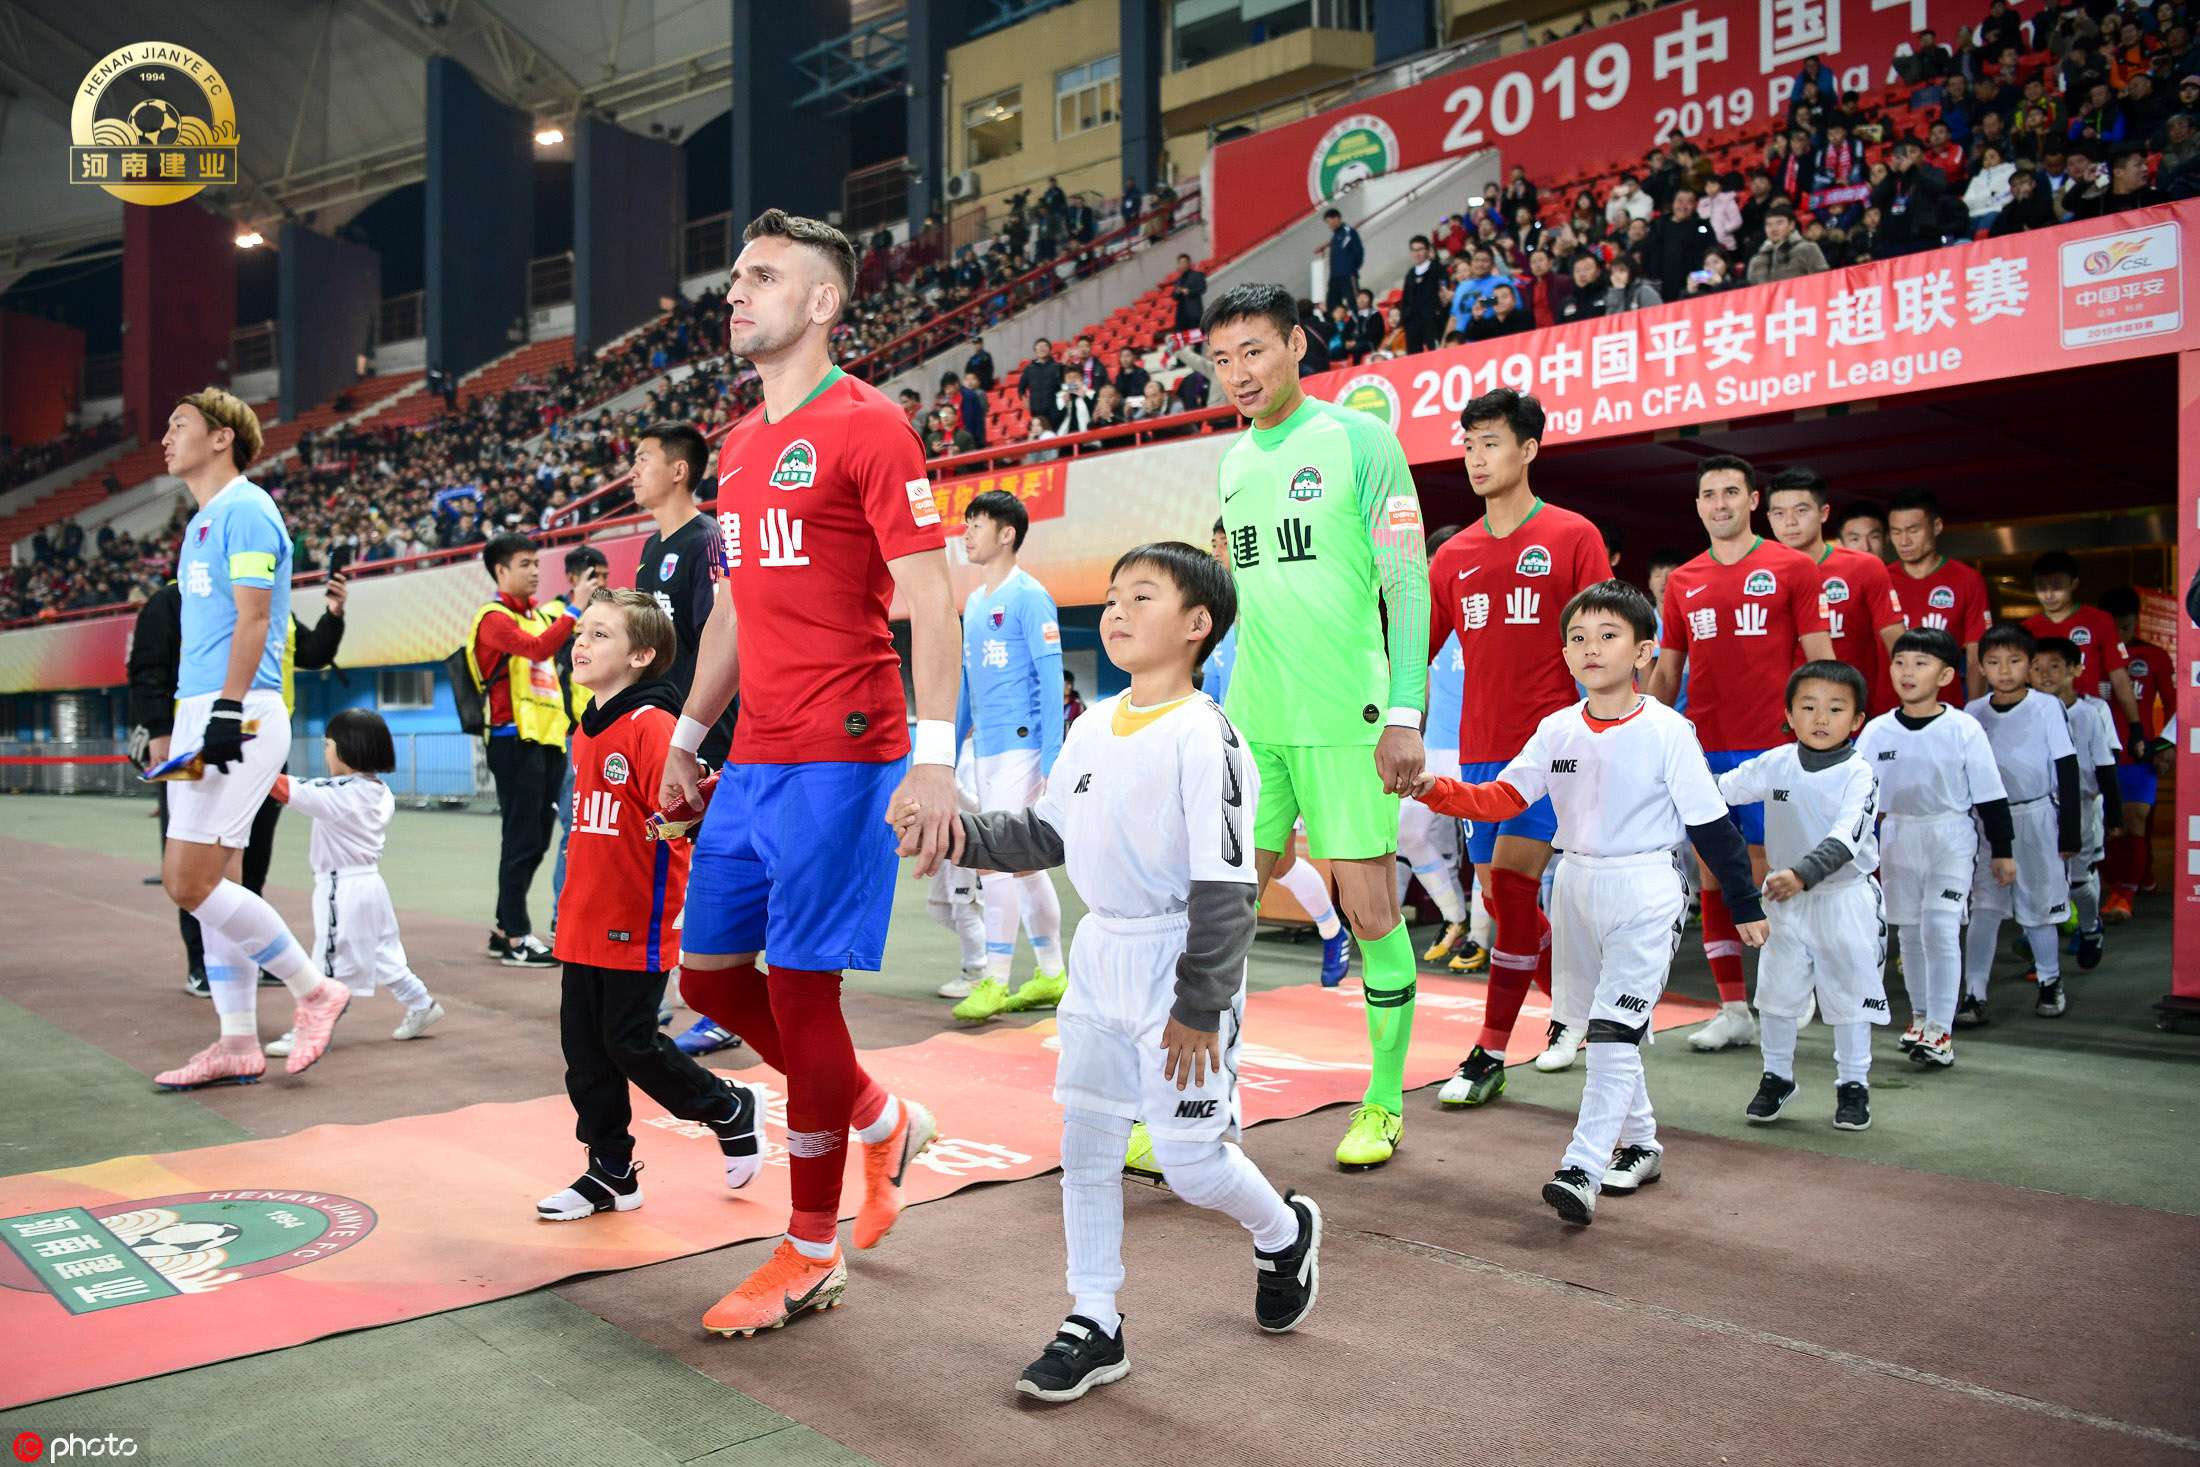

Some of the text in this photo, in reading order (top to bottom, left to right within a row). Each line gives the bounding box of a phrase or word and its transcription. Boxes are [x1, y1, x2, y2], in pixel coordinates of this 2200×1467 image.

[1654, 87, 1754, 146] 2019
[2121, 257, 2152, 271] CSL
[2076, 278, 2165, 307] 中国平安
[1591, 396, 1632, 424] An
[1642, 381, 1706, 415] CFA
[1716, 369, 1817, 406] Super
[1828, 347, 1962, 391] League
[1230, 518, 1317, 571] 建业
[1461, 587, 1541, 632] 建业
[1687, 602, 1768, 642] 建业
[1550, 759, 1578, 773] NIKE
[1941, 888, 1964, 902] NIKE
[1615, 994, 1649, 1013] NIKE
[1862, 998, 1888, 1011] NIKE
[1174, 1099, 1219, 1118] NIKE
[209, 1191, 363, 1258] HENAN JIANYE FC
[265, 1210, 306, 1229] 1994
[11, 1215, 151, 1305] 河南建业
